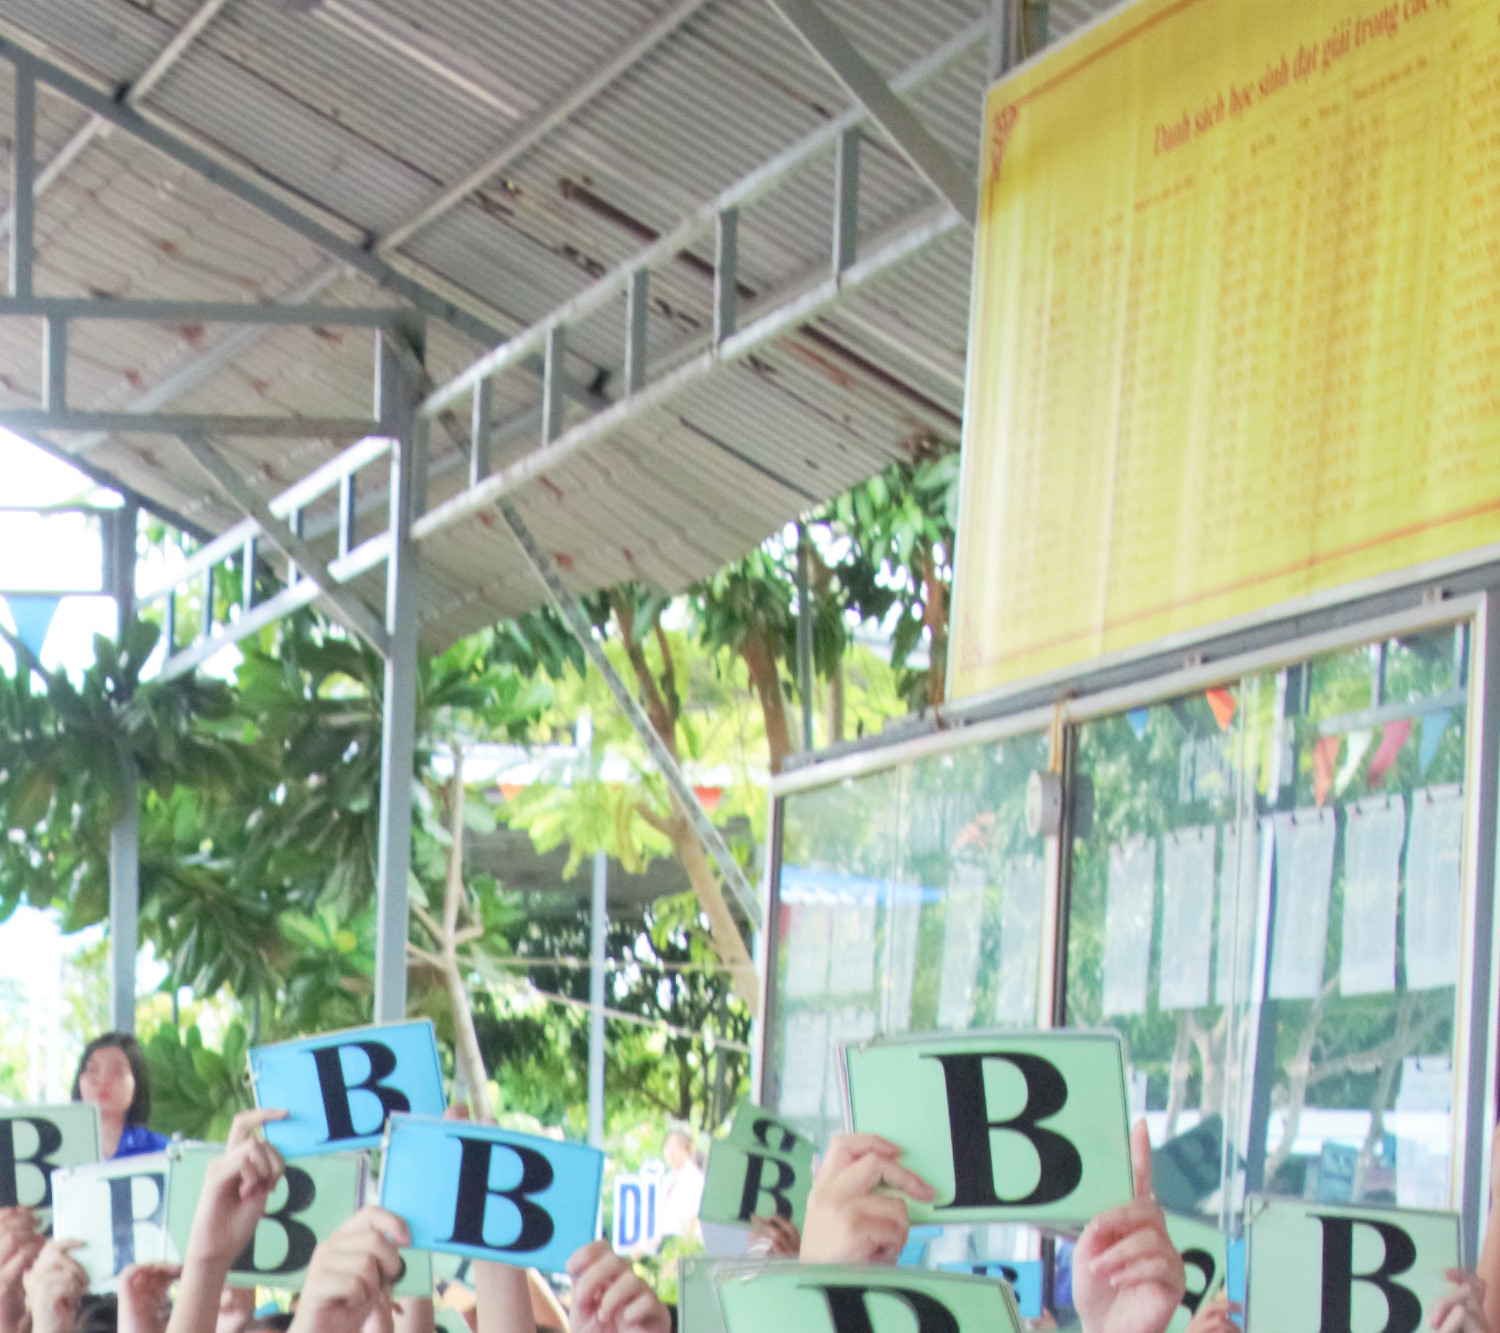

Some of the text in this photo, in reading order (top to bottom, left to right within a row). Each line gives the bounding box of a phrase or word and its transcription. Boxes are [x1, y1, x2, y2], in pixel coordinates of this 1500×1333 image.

[301, 1040, 411, 1144] B
[920, 1052, 1083, 1211] B
[228, 1164, 317, 1275] B
[434, 1134, 555, 1253] B
[739, 1152, 796, 1222] B
